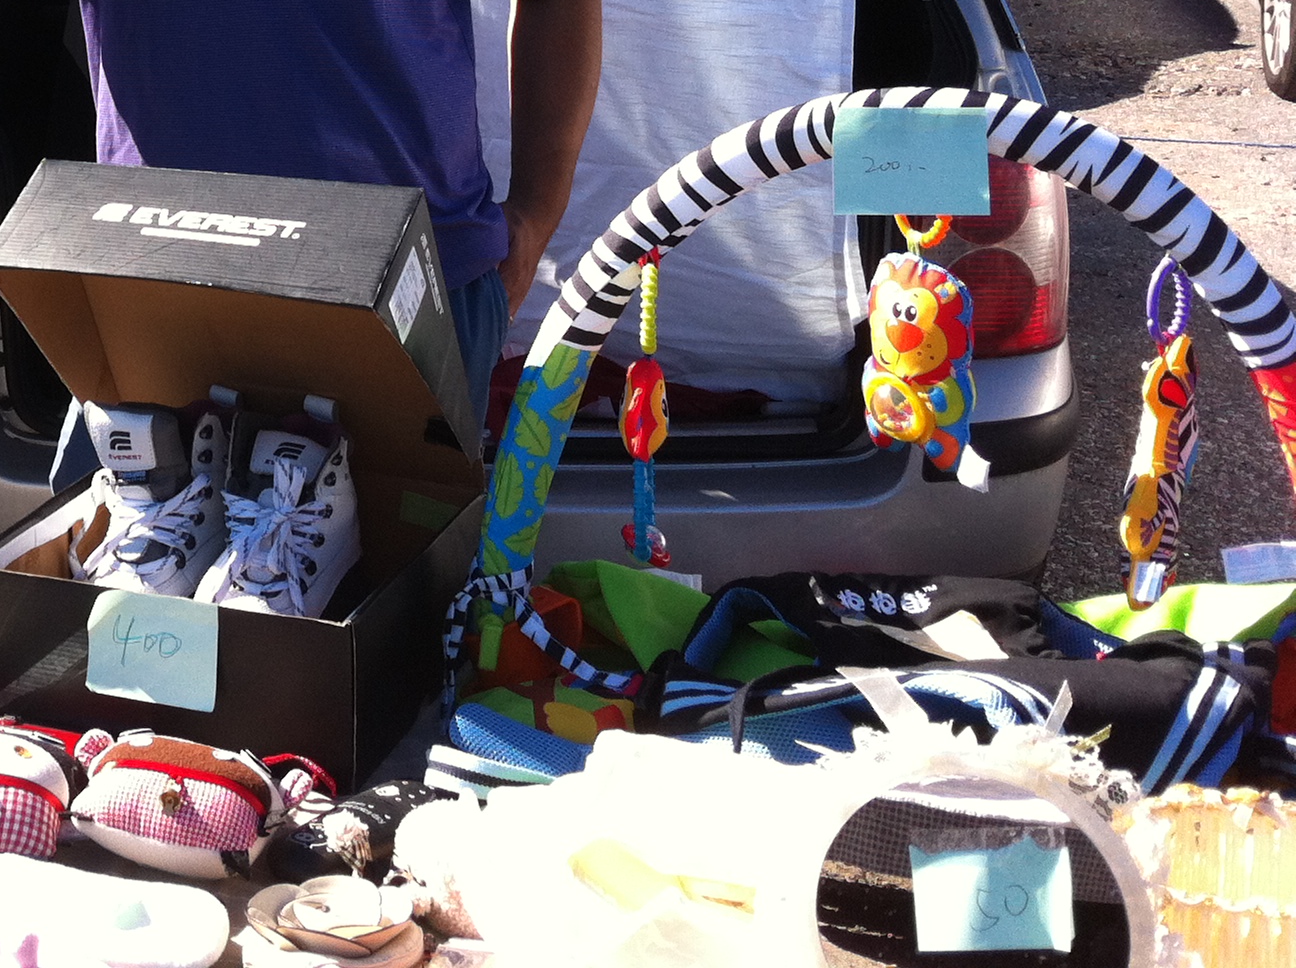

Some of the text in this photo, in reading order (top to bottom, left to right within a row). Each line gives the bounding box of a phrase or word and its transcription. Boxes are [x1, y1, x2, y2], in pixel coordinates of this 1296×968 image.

[108, 453, 143, 461] EVEREST
[112, 614, 183, 668] 400
[969, 883, 1030, 933] 50
